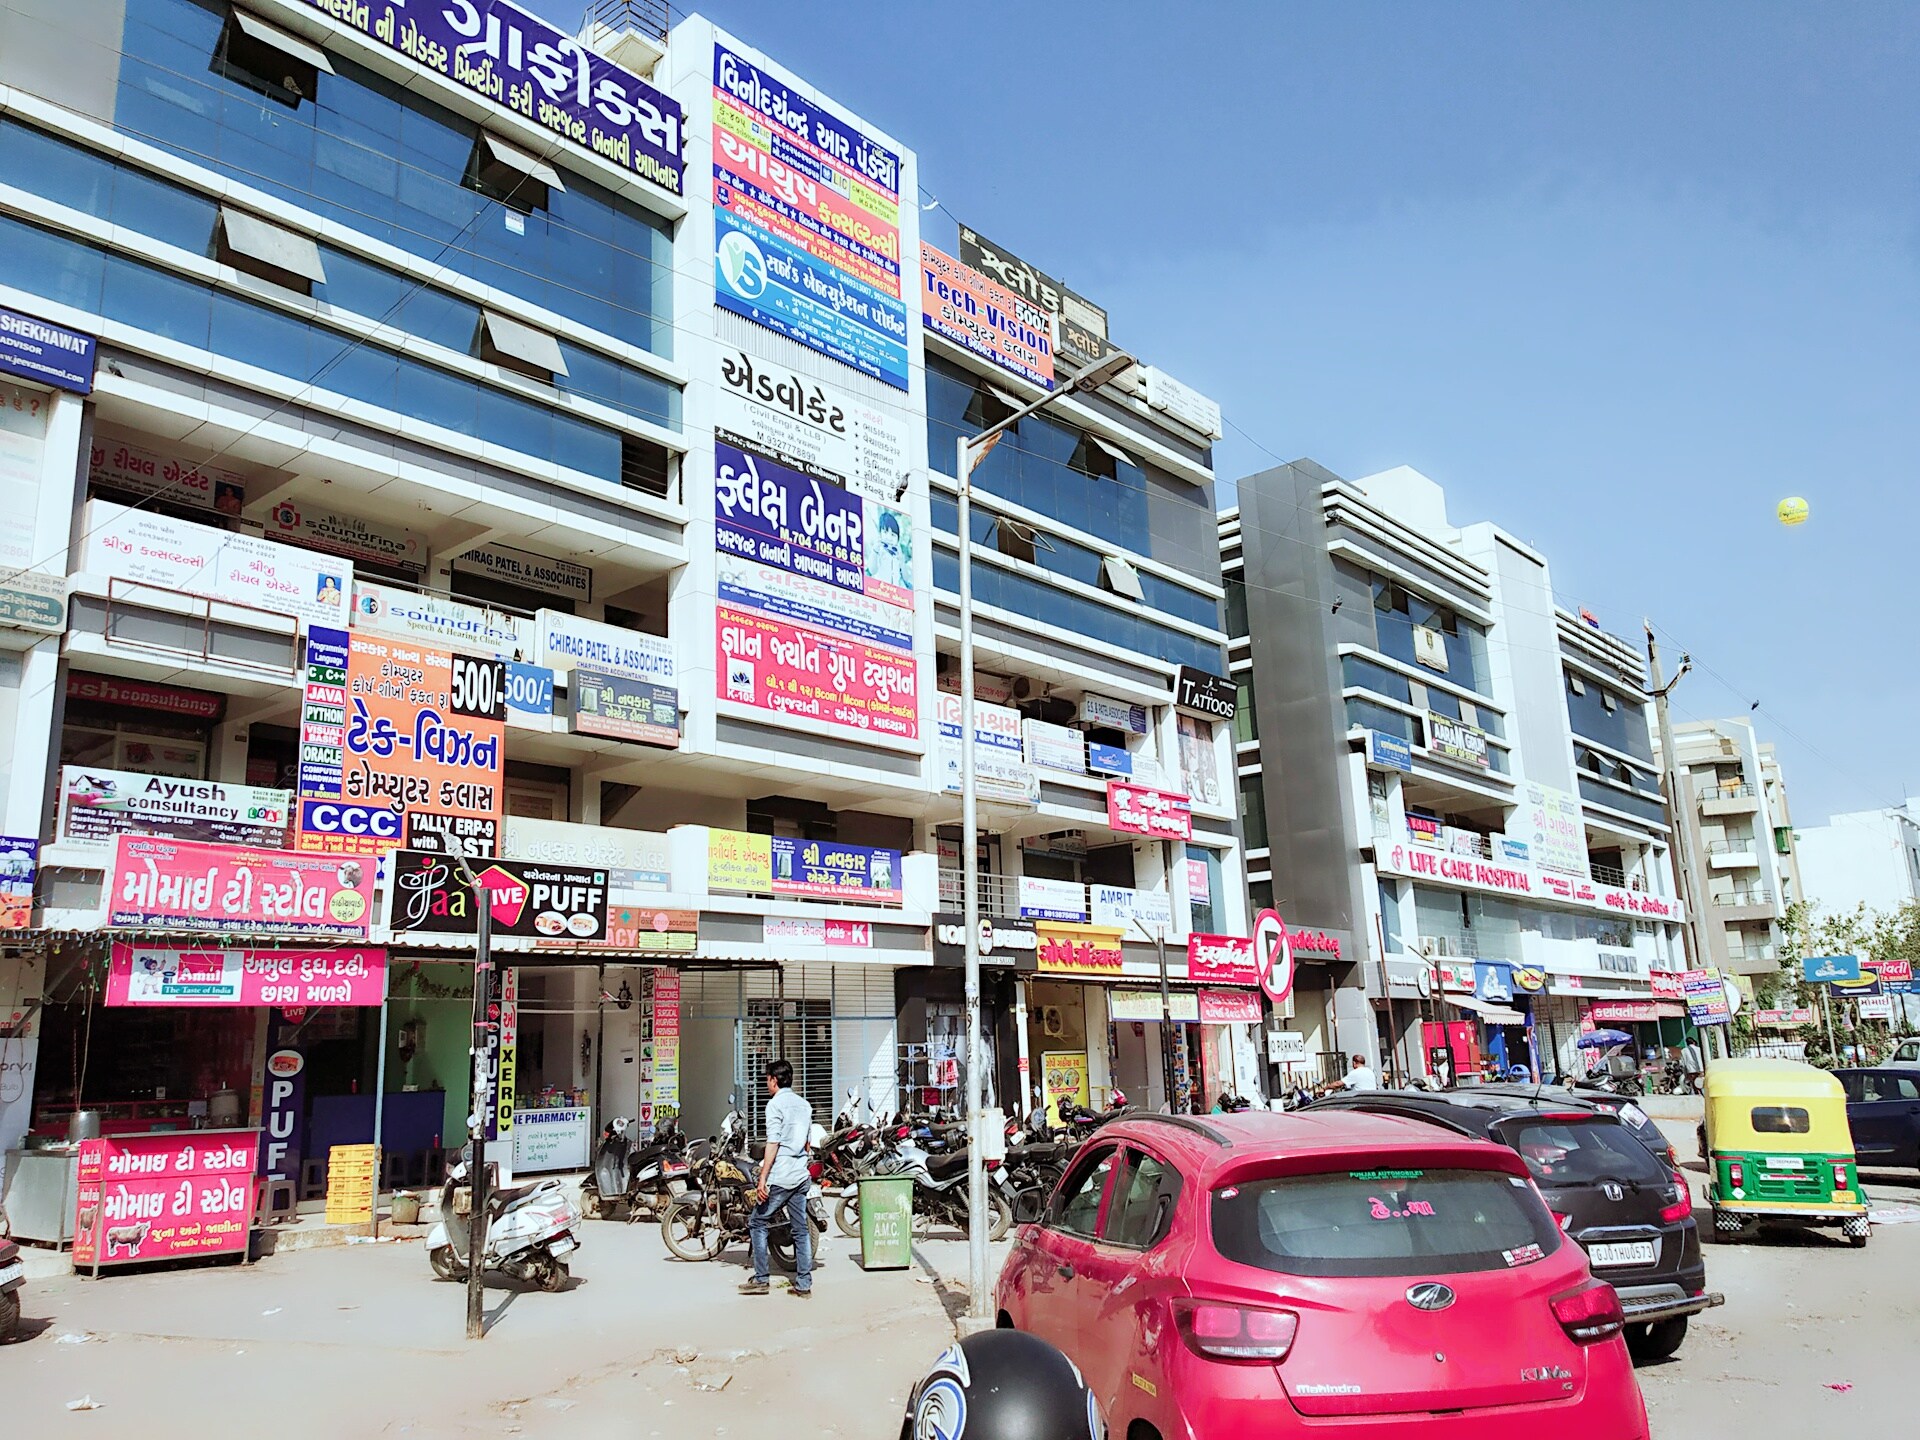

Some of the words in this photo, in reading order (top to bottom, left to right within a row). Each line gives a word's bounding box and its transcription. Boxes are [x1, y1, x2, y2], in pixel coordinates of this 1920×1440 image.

[508, 83, 533, 117] કરી
[591, 127, 629, 167] બનાવી
[635, 149, 679, 194] આપનાર
[719, 131, 816, 207] આયુષ
[833, 172, 847, 190] LIC
[924, 269, 1049, 356] Tech-Vision
[1015, 304, 1050, 335] 500/-
[0, 314, 89, 355] SHEKHAWAT
[0, 336, 43, 355] ADVISOR
[721, 352, 846, 433] એડવોકેટ
[803, 428, 821, 441] LLB
[113, 448, 155, 476] રીયલ
[800, 478, 862, 548] બેનર
[102, 535, 133, 554] શ્રીજી
[779, 526, 813, 549] M.704
[814, 537, 833, 555] 105
[835, 547, 848, 560] 66
[849, 552, 862, 566] 66
[230, 570, 260, 586] રીયલ
[249, 560, 275, 577] શ્રીજી
[495, 554, 522, 574] PATEL
[525, 564, 531, 576] &
[534, 566, 586, 590] ASSOCIATES
[759, 544, 790, 567] બનાવી
[794, 553, 833, 581] આપવામાં
[836, 566, 864, 591] આવશે
[486, 567, 519, 581] CHARTERED
[520, 576, 560, 590] ACCOUNTANTS
[407, 620, 437, 635] Speech
[438, 626, 445, 634] &
[446, 627, 478, 647] Hearing
[479, 633, 502, 647] Clinic
[721, 625, 762, 660] જ્ઞાન
[309, 639, 348, 656] Programming
[350, 640, 388, 657] સરકાર
[392, 647, 421, 662] માન્ય
[549, 630, 584, 657] CHIRAG
[586, 640, 612, 664] PATEL
[615, 647, 620, 664] &
[623, 649, 673, 677] ASSOCIATES
[314, 652, 344, 667] Language
[577, 660, 609, 674] CHARTERED
[610, 667, 648, 681] ACCOUNTANTS
[307, 686, 344, 703] JAVA
[379, 679, 404, 700] શીખો
[452, 659, 504, 714] 500/-
[727, 688, 755, 703] K-105
[120, 688, 217, 715] consultancy
[600, 686, 614, 703] શ્રી
[617, 694, 651, 710] નવકાર
[815, 686, 838, 702] Bcom
[843, 692, 866, 709] Mcom
[1182, 678, 1235, 718] TATTOOS
[306, 705, 343, 725] PYTHON
[773, 693, 819, 715] ગુજરાતી
[873, 714, 907, 733] માધ્યમ
[306, 725, 343, 736] VISUAL
[308, 734, 339, 745] BASIC
[347, 697, 498, 771] ટેક-વિઝન
[1434, 723, 1464, 750] AARAM
[304, 745, 342, 764] ORACLE
[301, 773, 342, 785] HARDWARE
[302, 765, 342, 775] COMPUTER
[145, 777, 226, 801] Ayush
[71, 814, 110, 826] Business
[111, 818, 132, 827] Loan
[72, 806, 97, 816] Home
[98, 808, 120, 818] Loan
[132, 812, 172, 824] Mortgage
[174, 816, 194, 826] Loan
[311, 805, 396, 836] CCC
[411, 814, 451, 837] TALLY
[455, 816, 494, 838] ERP-9
[70, 822, 86, 832] Car
[88, 824, 109, 833] Loan
[70, 830, 91, 840] Land
[412, 836, 438, 850] with
[527, 844, 577, 864] નવકાર
[632, 842, 667, 870] ડીલર
[742, 847, 770, 868] એવન્યુ
[802, 842, 820, 865] શ્રી
[824, 852, 867, 870] નવકાર
[523, 870, 561, 883] ચરોતરના
[840, 871, 863, 887] ડીલર
[1408, 850, 1438, 875] LIFE
[1440, 857, 1474, 881] CARE
[1475, 863, 1531, 892] HOSPITAL
[123, 858, 218, 915] મોમાઈ
[222, 866, 253, 914] ટી
[260, 870, 327, 919] સ્ટોલ
[532, 883, 603, 913] PUFF
[1100, 889, 1134, 906] AMRIT
[1026, 908, 1039, 916] Call
[1145, 910, 1171, 923] CLINIC
[223, 920, 242, 931] તથા
[766, 920, 799, 937] આશીર્વાદ
[801, 920, 826, 941] એવન્યુ
[245, 955, 294, 976] અમુલ
[999, 957, 1015, 965] SALON
[177, 969, 222, 983] Amul
[164, 986, 178, 995] The
[179, 986, 200, 995] Taste
[202, 986, 210, 995] of
[212, 985, 232, 995] India
[261, 984, 300, 1003] છાશ
[306, 982, 352, 1003] મળશે
[284, 1006, 305, 1019] LIVE
[1276, 1039, 1304, 1052] PARKING
[524, 1111, 578, 1125] PHARMACY
[175, 1145, 194, 1171] ટી
[202, 1143, 247, 1169] સ્ટોલ
[1350, 1171, 1376, 1179] PUNJAB
[1377, 1170, 1424, 1178] AUTOMOBILES
[171, 1180, 194, 1217] ટી
[200, 1177, 245, 1214] સ્ટોલ
[179, 1223, 201, 1237] અને
[204, 1221, 243, 1234] જાણીતા
[1596, 1244, 1653, 1262] GJ01HU0573
[1296, 1383, 1361, 1394] Mahindra
